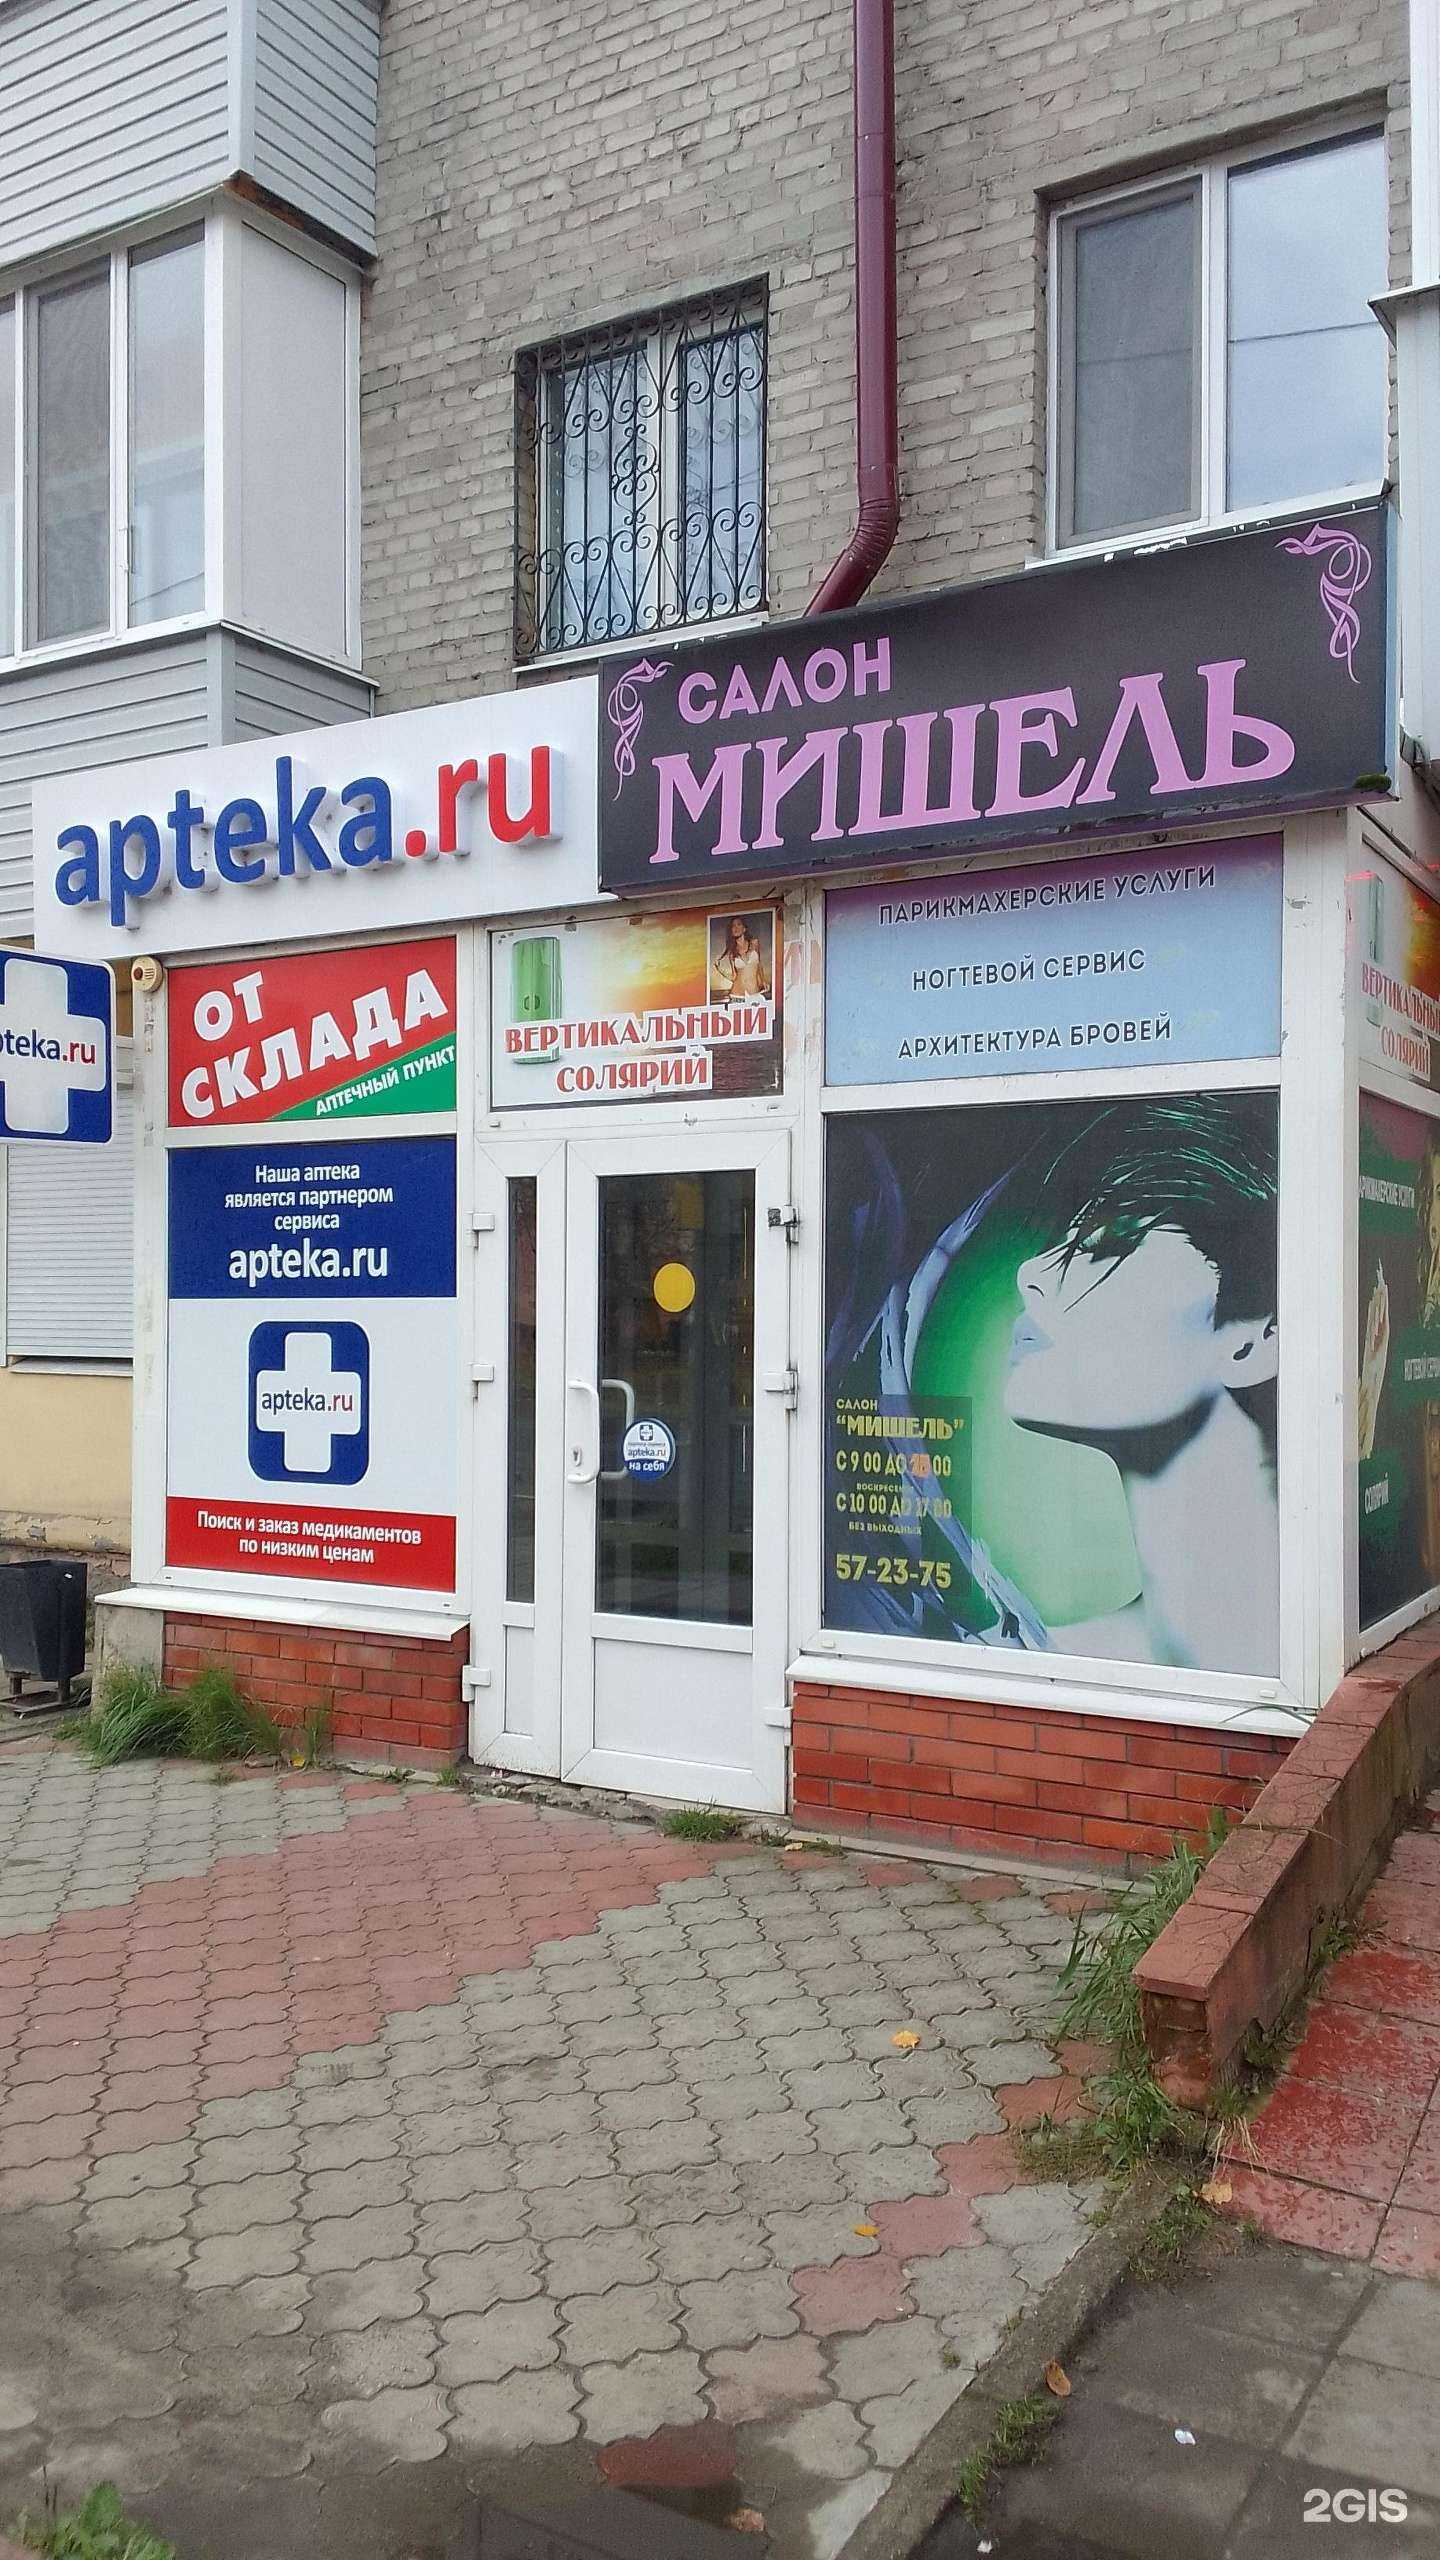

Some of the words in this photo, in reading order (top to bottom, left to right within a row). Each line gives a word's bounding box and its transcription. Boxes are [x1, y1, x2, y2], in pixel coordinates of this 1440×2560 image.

[678, 637, 891, 725] САЛОН
[649, 658, 1296, 865] МИШЕЛЬ
[55, 745, 552, 928] apteka.ru
[879, 879, 1105, 925] ПАРИКМАХЕРСКИЕ
[1114, 865, 1216, 897] УСЛУГИ
[913, 954, 1035, 991] НОГТЕВОЙ
[1043, 949, 1145, 978] СЕРВИС
[194, 971, 263, 1041] ОТ
[1362, 962, 1440, 1036] ВЕРТИКАЛЬНЫ
[0, 1029, 96, 1064] teka.ru
[182, 969, 448, 1119] СКЛАДА
[505, 1002, 768, 1053] ВЕРТИКАЛЬНЫЙ
[898, 1027, 1061, 1059] АРХИТЕКТУРА
[1070, 1011, 1171, 1046] БРОВЕЙ
[1382, 1026, 1429, 1075] СОЛЯРИЙ
[315, 1067, 399, 1116] АПТЕЧНЫЙ
[403, 1045, 455, 1081] ПУНКТ
[556, 1052, 708, 1094] СОЛЯРИЙ
[255, 1165, 300, 1183] Наша
[304, 1164, 360, 1182] аптека
[224, 1191, 295, 1208] является
[299, 1188, 393, 1209] партнером
[274, 1214, 339, 1234] сервиса
[229, 1238, 388, 1288] apteka.ru
[262, 1387, 353, 1415] apteka.ru
[836, 1399, 878, 1411] САЛОН
[629, 1461, 641, 1471] на
[643, 1460, 665, 1472] себя
[836, 1450, 847, 1471] С
[850, 1451, 859, 1473] 9
[863, 1452, 881, 1474] 00
[885, 1453, 906, 1476] ДО
[933, 1455, 951, 1476] 00
[836, 1493, 847, 1512] С
[849, 1493, 864, 1513] 10
[869, 1494, 886, 1514] 00
[197, 1510, 242, 1531] Поиск
[244, 1518, 255, 1532] и
[258, 1518, 299, 1535] заказ
[301, 1522, 422, 1545] медикаментов
[849, 1521, 866, 1532] БЕЗ
[239, 1538, 257, 1553] по
[261, 1539, 320, 1559] низким
[322, 1546, 375, 1564] ценам
[836, 1553, 951, 1589] 57-23-75
